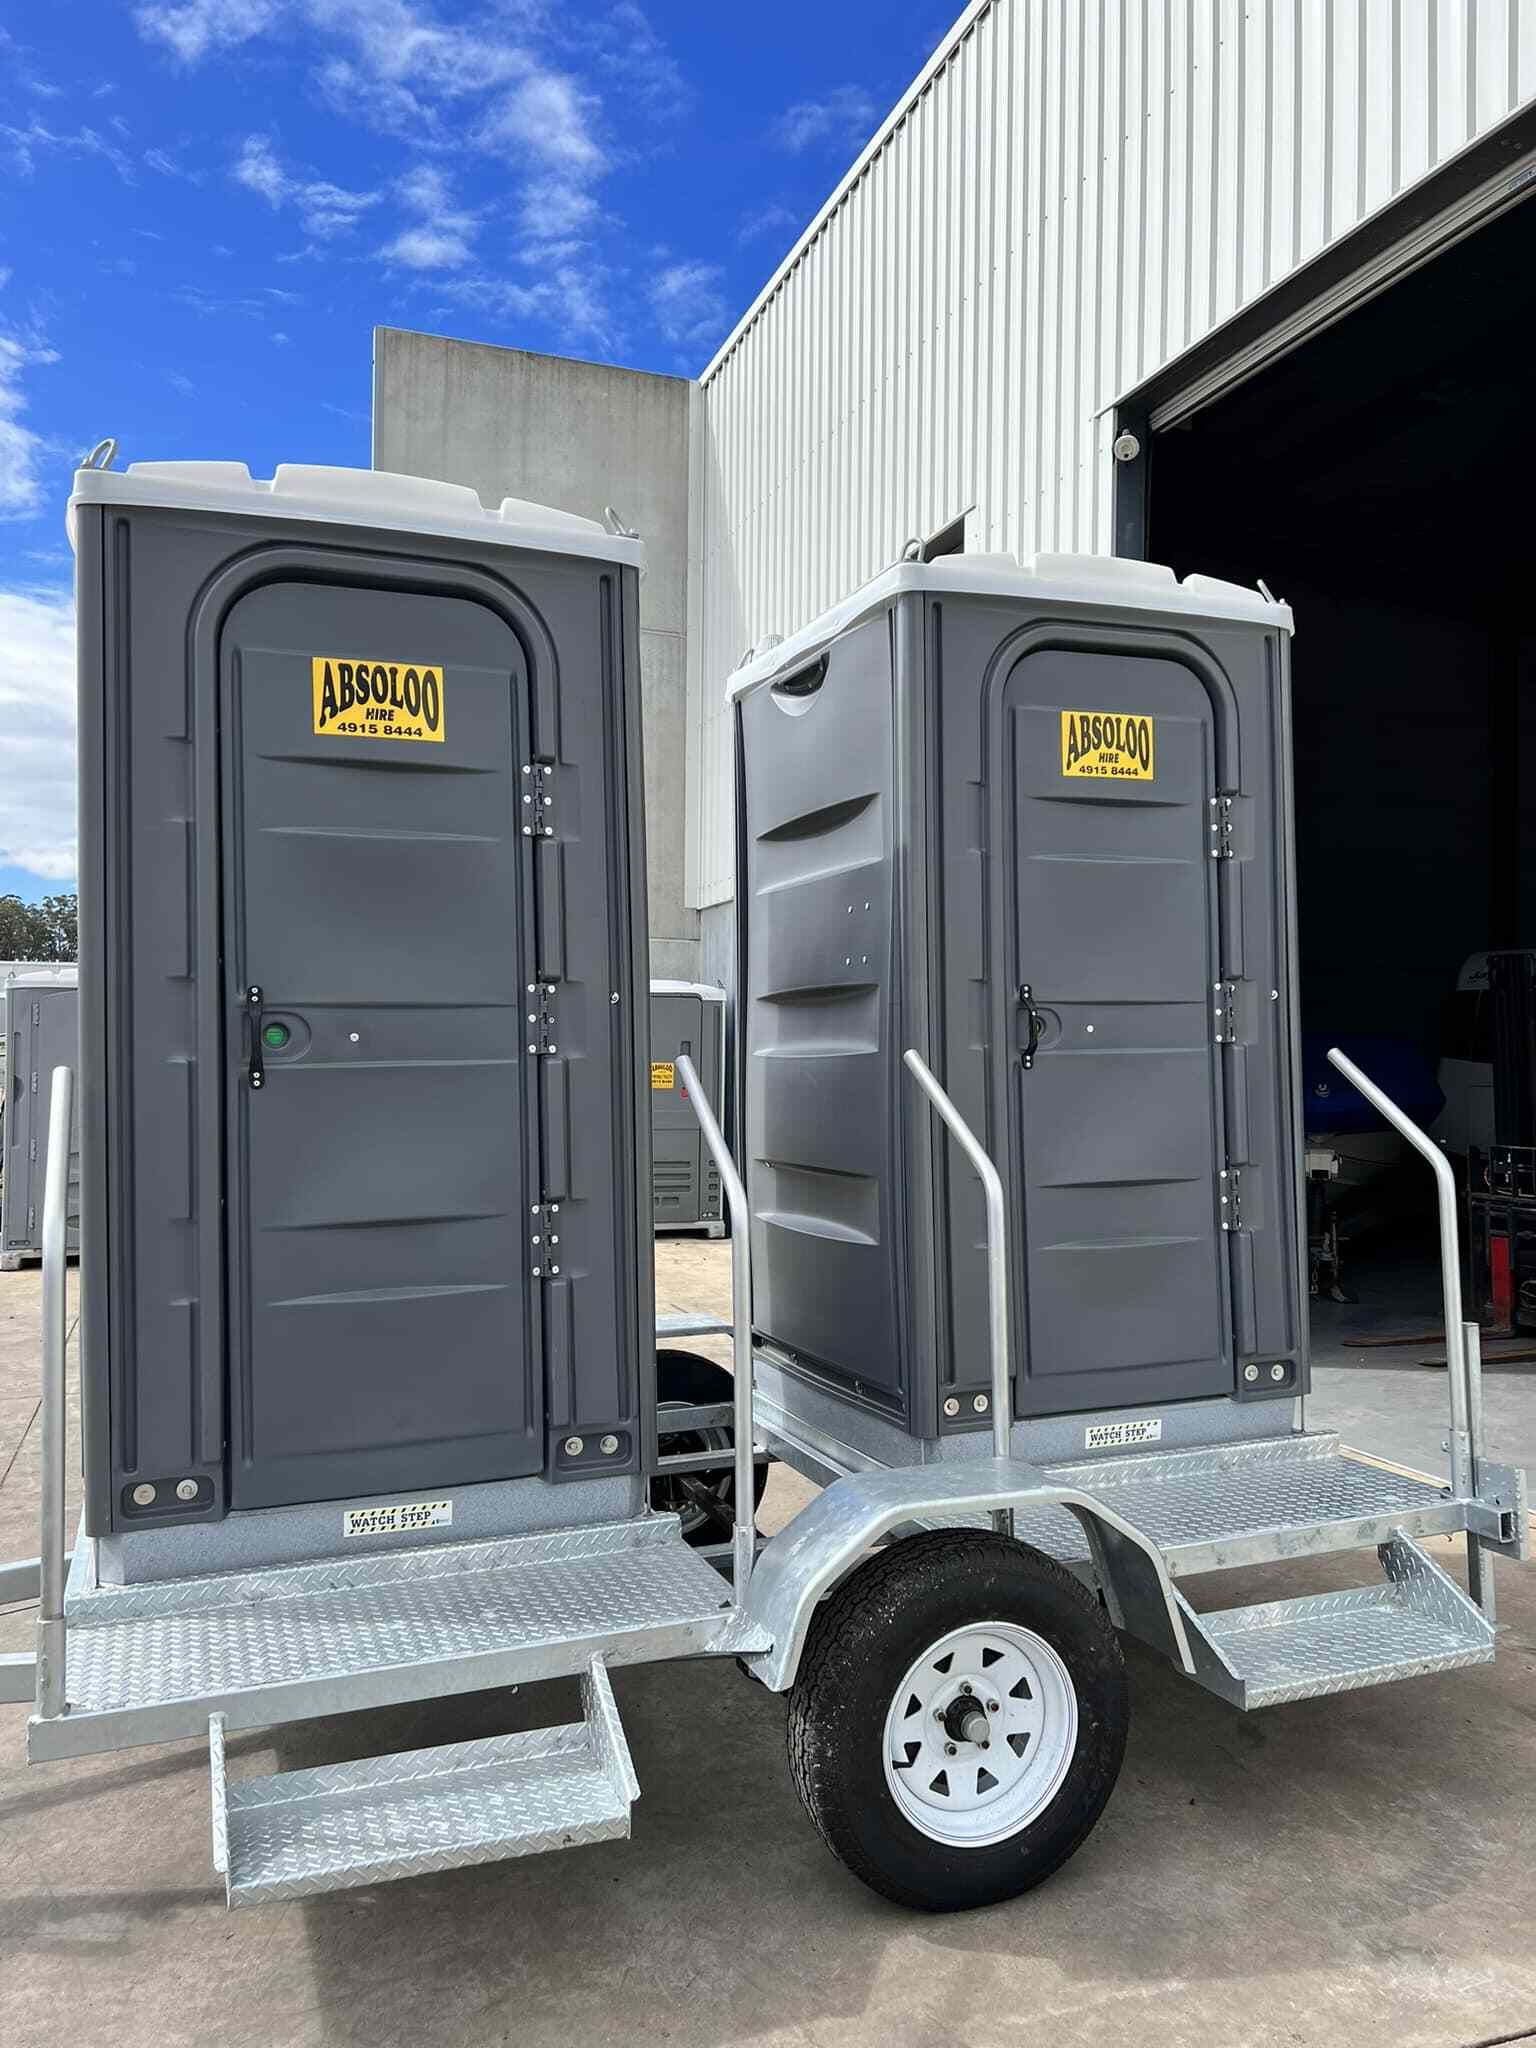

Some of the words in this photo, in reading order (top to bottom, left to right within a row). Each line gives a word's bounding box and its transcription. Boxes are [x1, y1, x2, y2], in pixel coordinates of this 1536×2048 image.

[319, 660, 439, 732] ABSOLOO
[365, 708, 395, 721] HIRE
[337, 722, 378, 734] 4915
[383, 725, 423, 737] 8444
[1066, 714, 1150, 771] ABSOLOO
[1099, 752, 1119, 763] HIRE
[1079, 766, 1107, 775] 4915
[1111, 767, 1138, 776] 8444
[1090, 1431, 1121, 1441] WATCH
[1125, 1428, 1147, 1437] STEP
[351, 1515, 395, 1528] WATCH
[400, 1511, 432, 1523] STEP
